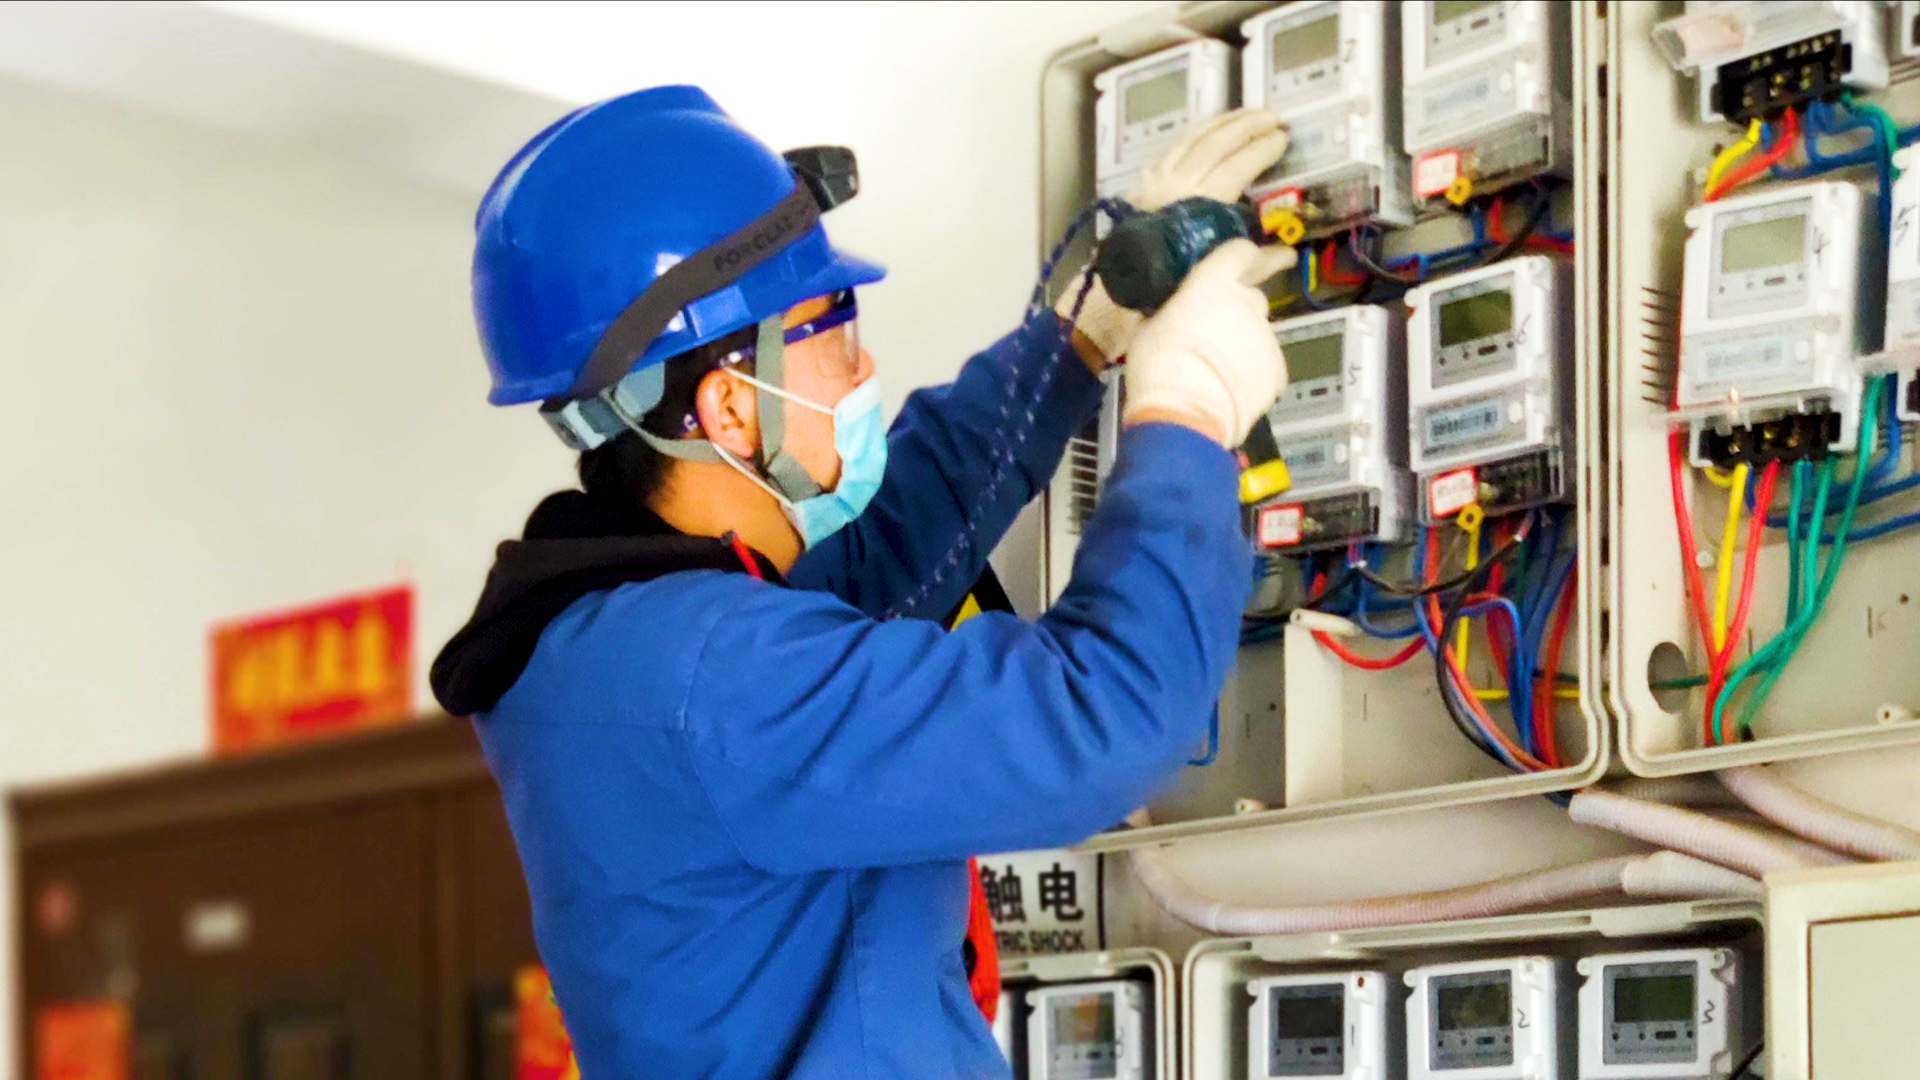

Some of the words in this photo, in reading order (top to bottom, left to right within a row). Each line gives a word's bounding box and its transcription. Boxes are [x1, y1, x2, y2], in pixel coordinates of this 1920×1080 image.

[979, 862, 1084, 923] 触电
[1029, 929, 1086, 953] SHOCK
[1517, 1009, 1531, 1028] 2
[1702, 1001, 1716, 1024] 3
